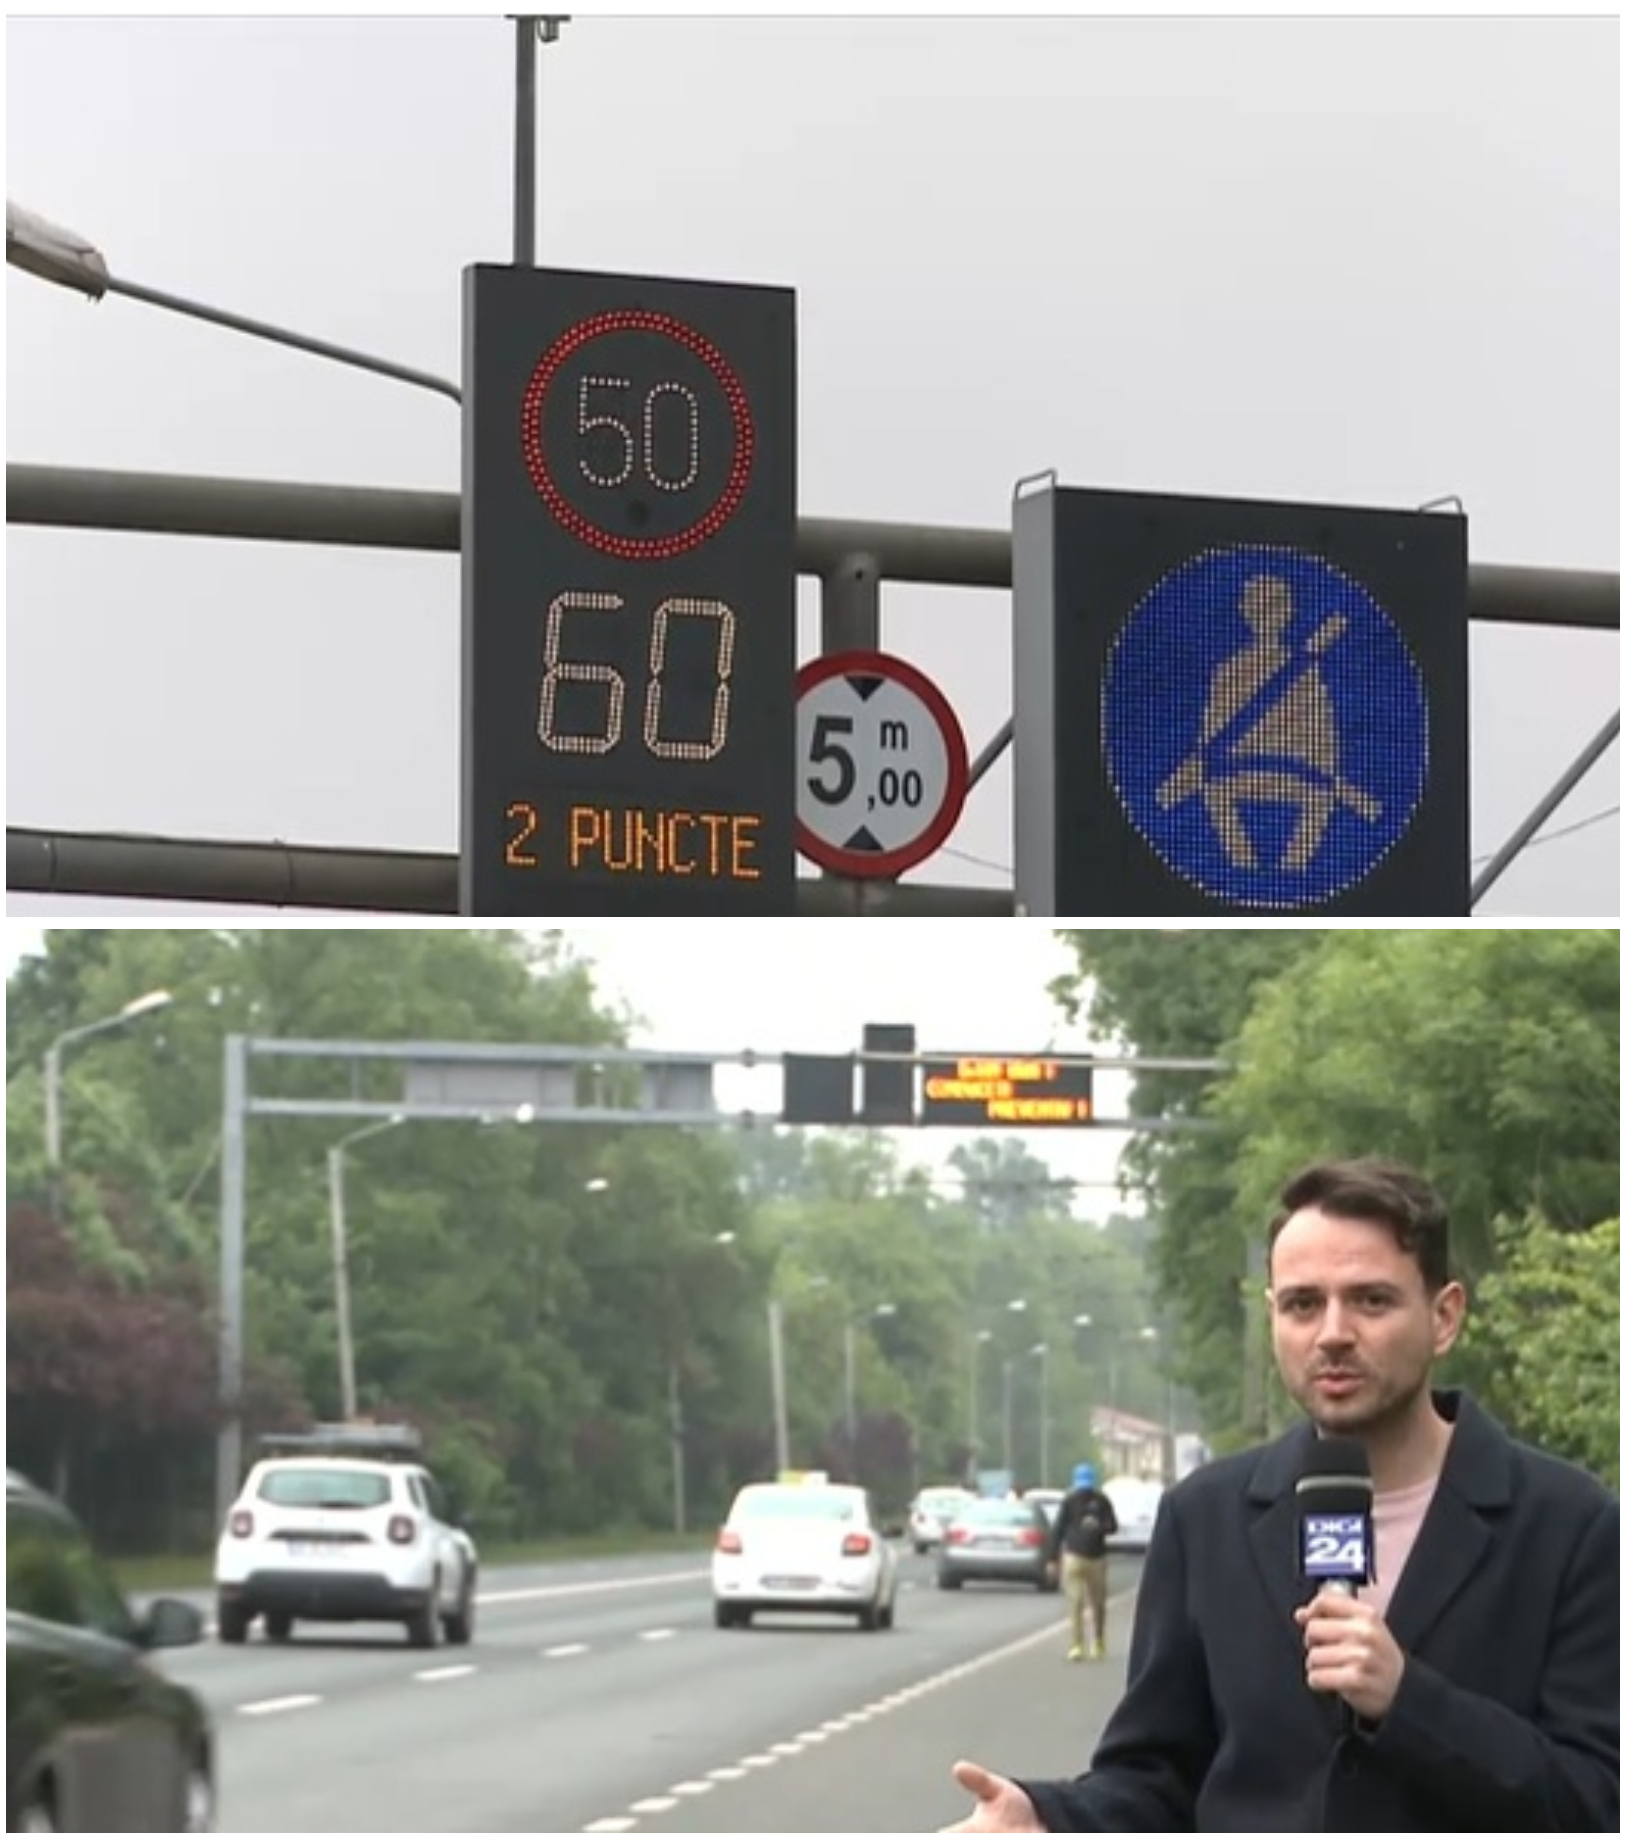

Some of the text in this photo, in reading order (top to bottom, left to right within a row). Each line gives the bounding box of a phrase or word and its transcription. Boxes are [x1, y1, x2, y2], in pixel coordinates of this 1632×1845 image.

[578, 375, 699, 491] 50
[537, 591, 736, 760] 60
[879, 720, 909, 751] m
[505, 803, 761, 878] 2 PUNCTE
[1307, 1518, 1363, 1534] DIGI
[1305, 1537, 1365, 1571] 24
